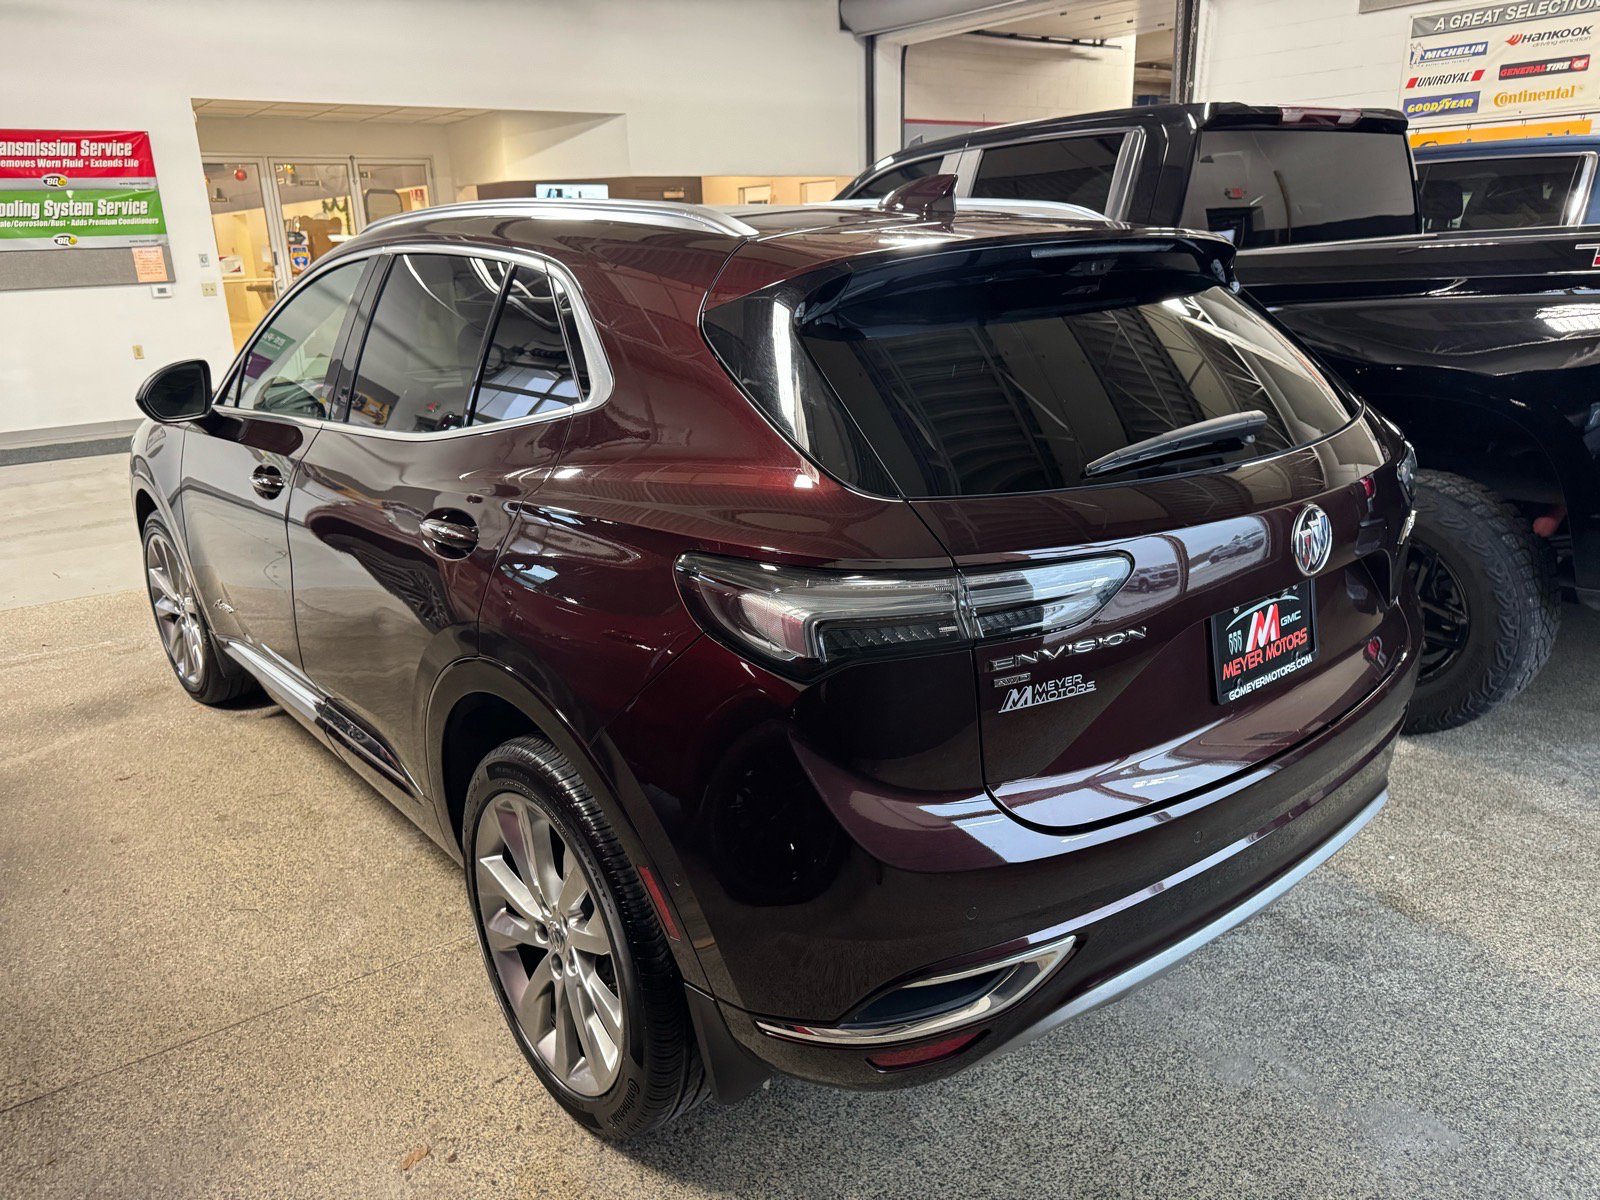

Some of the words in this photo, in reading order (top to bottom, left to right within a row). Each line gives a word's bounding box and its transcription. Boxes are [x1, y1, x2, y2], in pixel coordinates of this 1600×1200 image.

[1434, 18, 1445, 31] A
[1449, 9, 1506, 29] GREAT
[1424, 43, 1486, 60] MICHELIN
[1417, 72, 1470, 87] UNIROYAL
[1407, 97, 1474, 113] GOODYEAR
[1493, 85, 1576, 107] Continental
[80, 139, 133, 157] Service
[37, 159, 61, 168] Worn
[62, 158, 84, 168] Fluid
[90, 159, 123, 168] Extends
[124, 158, 140, 168] Life
[44, 199, 94, 220] System
[97, 198, 148, 216] Service
[71, 219, 87, 227] Adds
[89, 218, 117, 227] Premium
[118, 217, 159, 226] Conditioners
[1280, 610, 1302, 627] GMC
[988, 626, 1148, 672] ENVISION
[1222, 650, 1264, 681] MEYER
[1265, 627, 1308, 662] MOTORS
[1034, 674, 1083, 694] MEYER
[1228, 654, 1313, 701] GOMEYERMOTORS.COM
[1034, 680, 1096, 704] MOTORS
